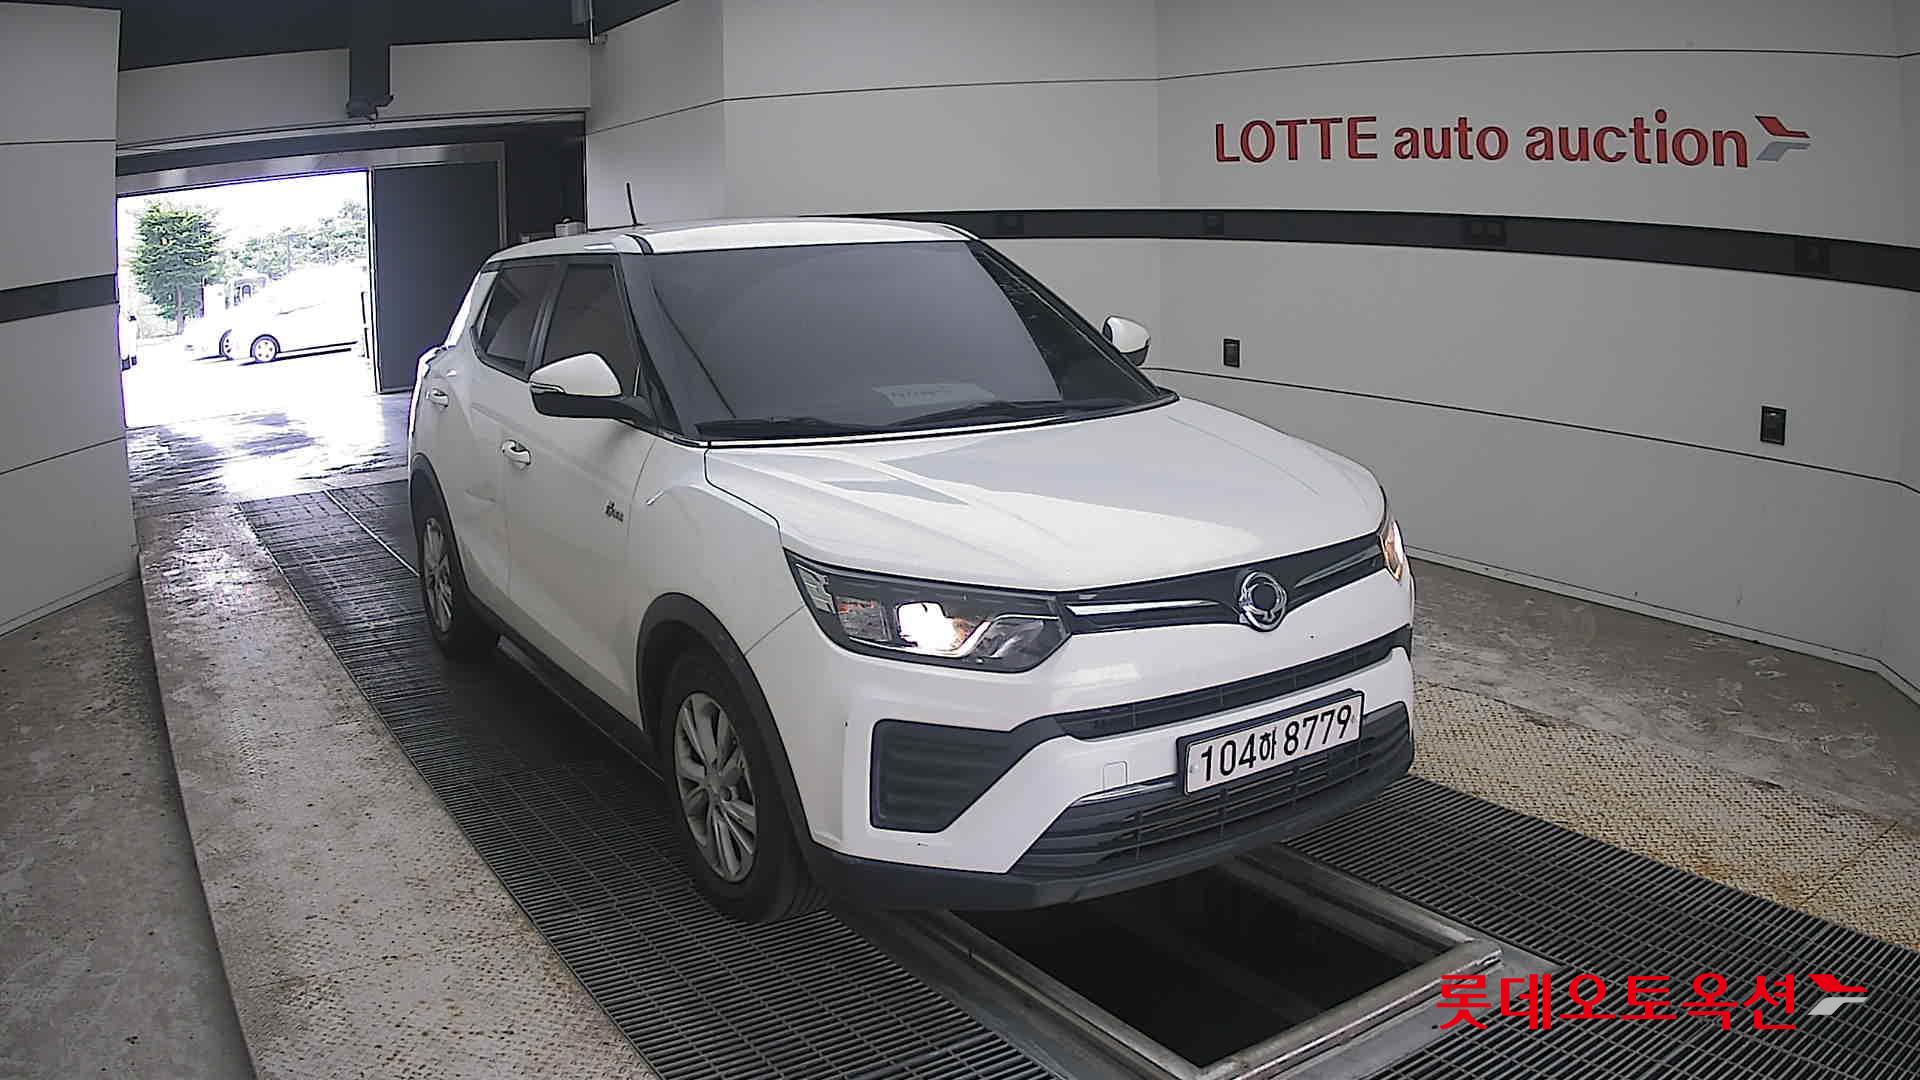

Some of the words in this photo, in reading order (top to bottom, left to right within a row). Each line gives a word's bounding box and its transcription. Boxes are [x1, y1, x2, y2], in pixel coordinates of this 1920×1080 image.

[1215, 116, 1377, 162] LOTTE
[1394, 117, 1510, 161] auto
[1525, 109, 1749, 168] auction
[1201, 727, 1277, 782] 104하
[1284, 704, 1352, 756] 8779
